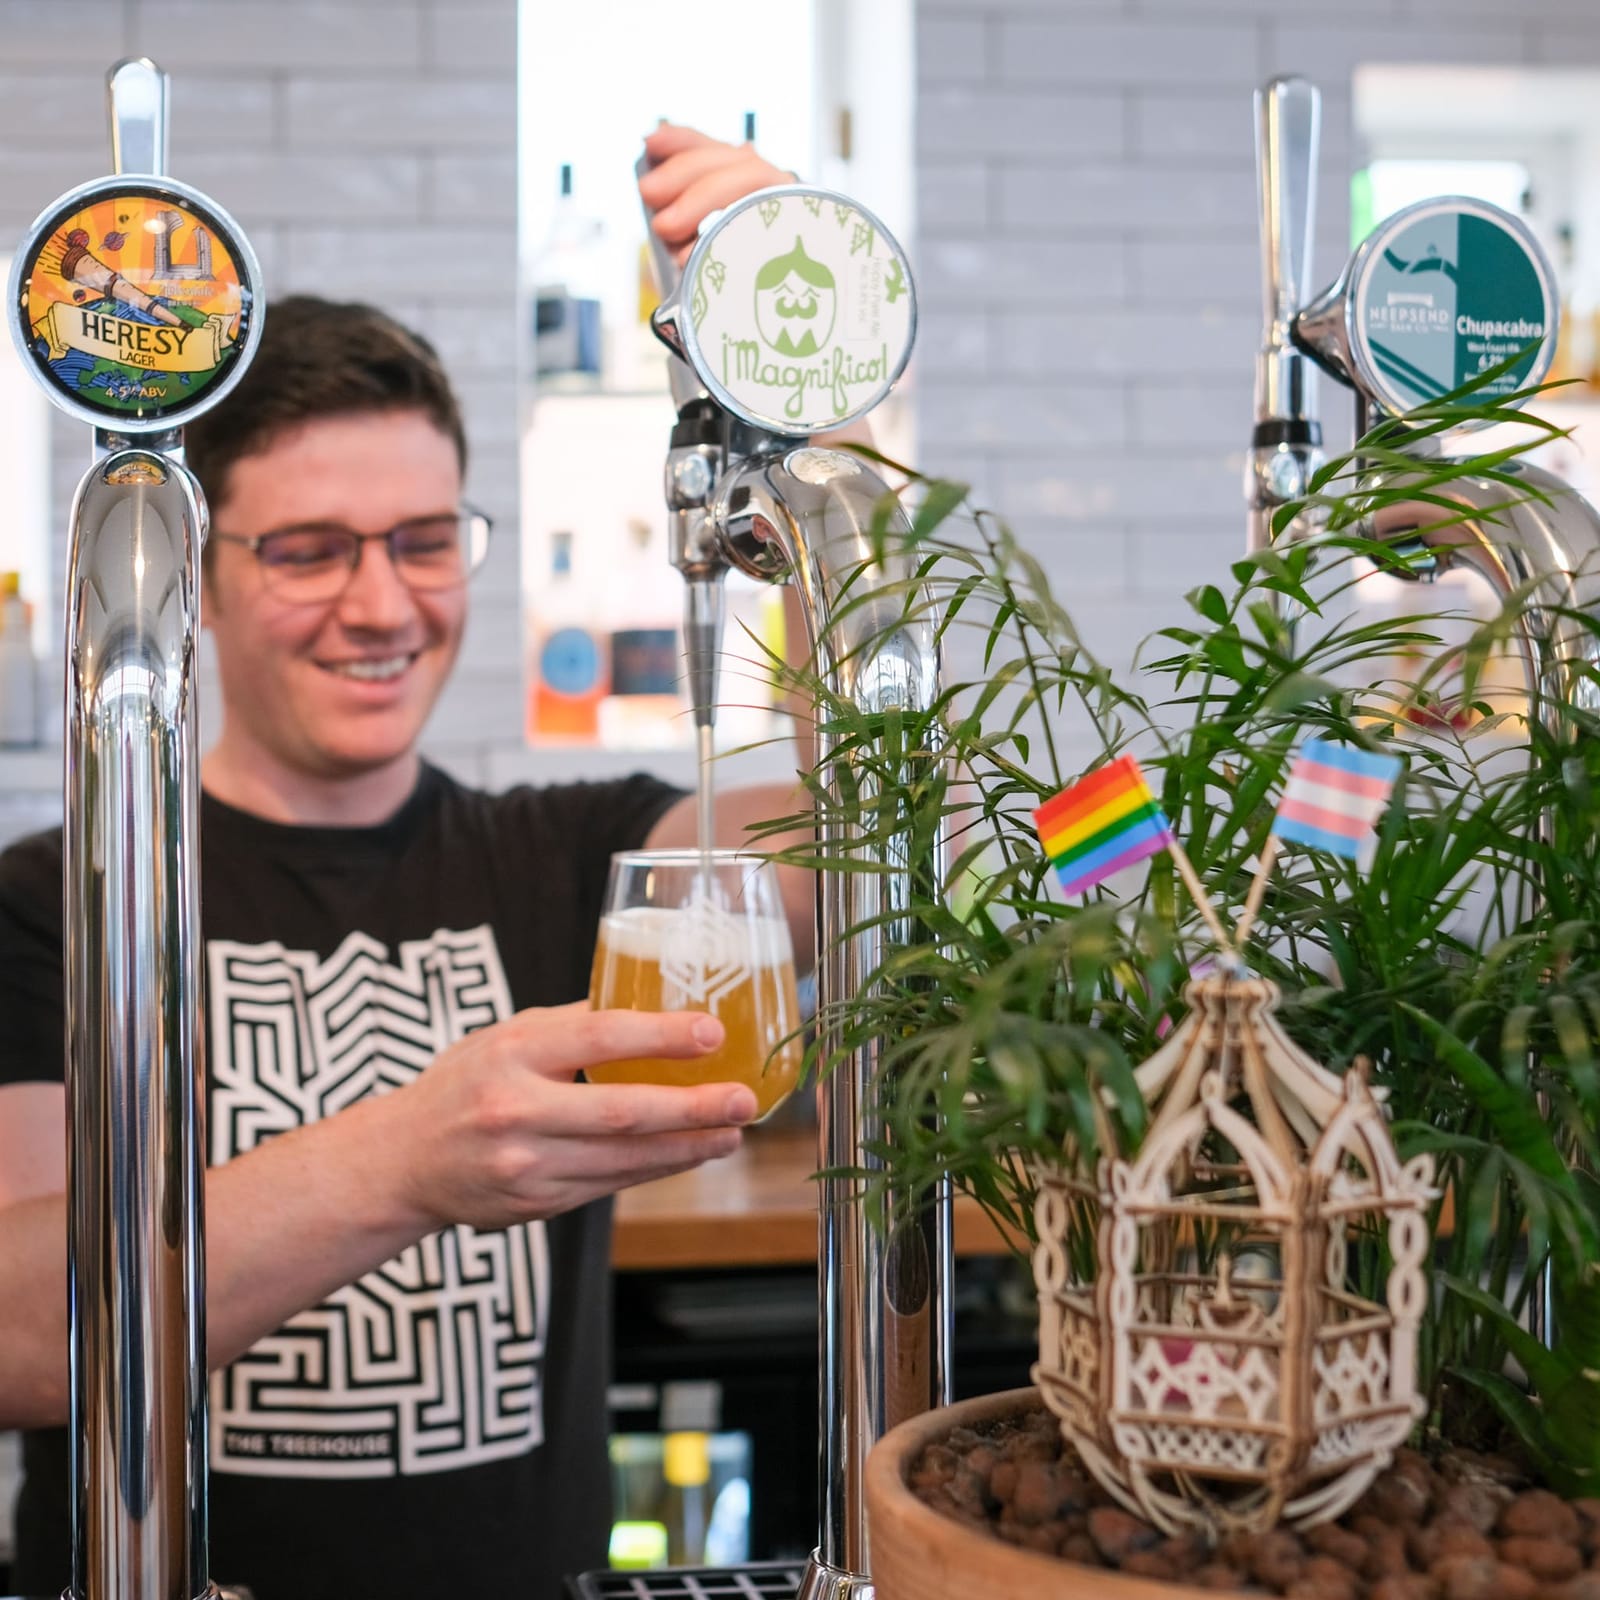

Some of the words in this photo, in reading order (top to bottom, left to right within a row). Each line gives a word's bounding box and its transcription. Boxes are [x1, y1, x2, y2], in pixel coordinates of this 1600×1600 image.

[82, 312, 190, 355] HERESY
[1456, 315, 1543, 341] Chupacabra
[118, 349, 156, 368] LAGER
[138, 386, 167, 399] ABV
[228, 1433, 263, 1453] THE
[270, 1433, 390, 1457] TREEHOUSE
